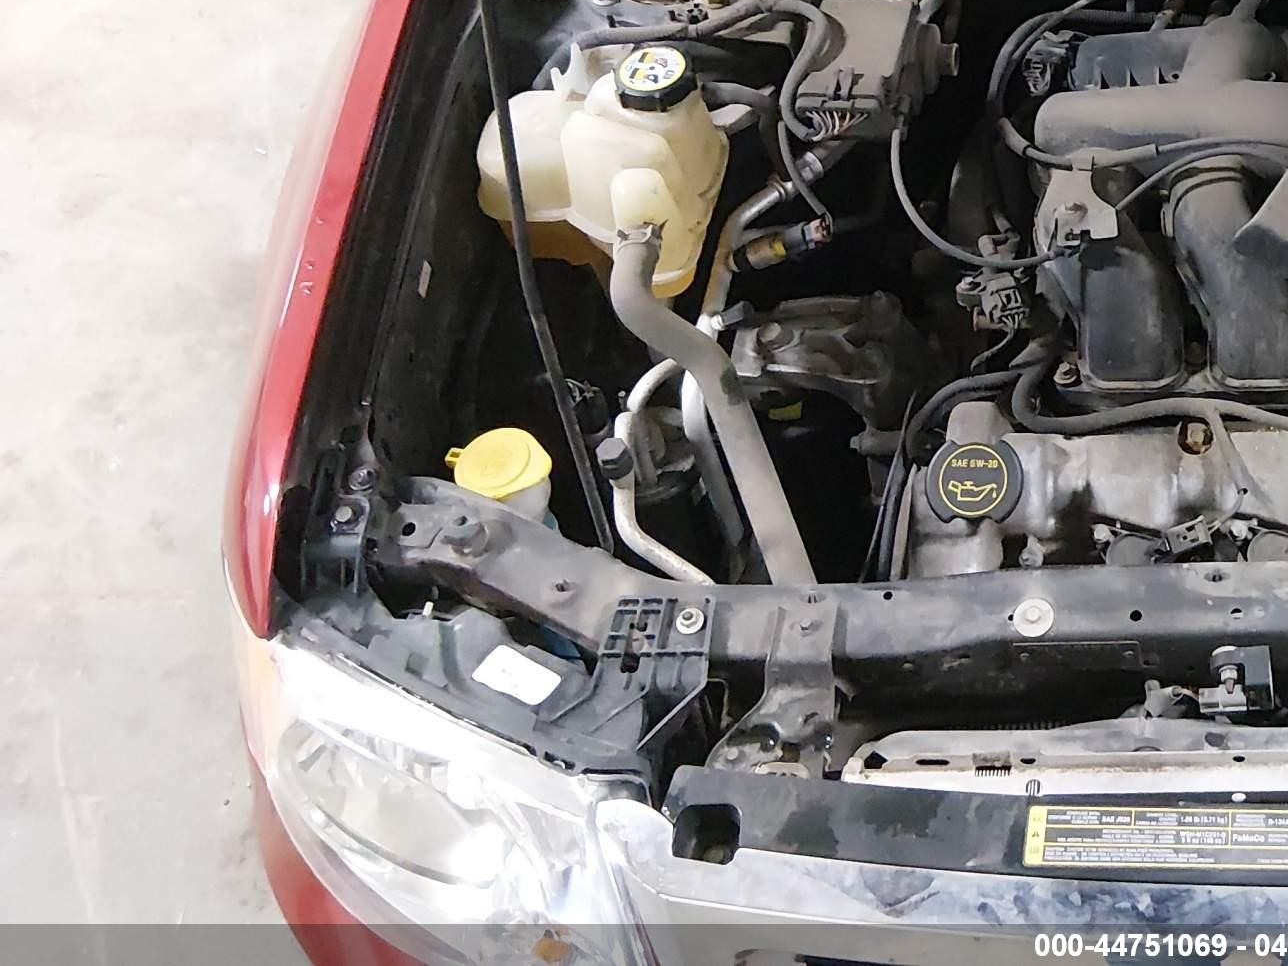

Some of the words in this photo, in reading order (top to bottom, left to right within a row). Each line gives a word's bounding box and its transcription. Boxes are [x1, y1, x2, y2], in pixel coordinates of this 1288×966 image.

[951, 459, 969, 468] SAE
[970, 459, 998, 469] 5W-20
[1232, 833, 1265, 843] FoMoCo
